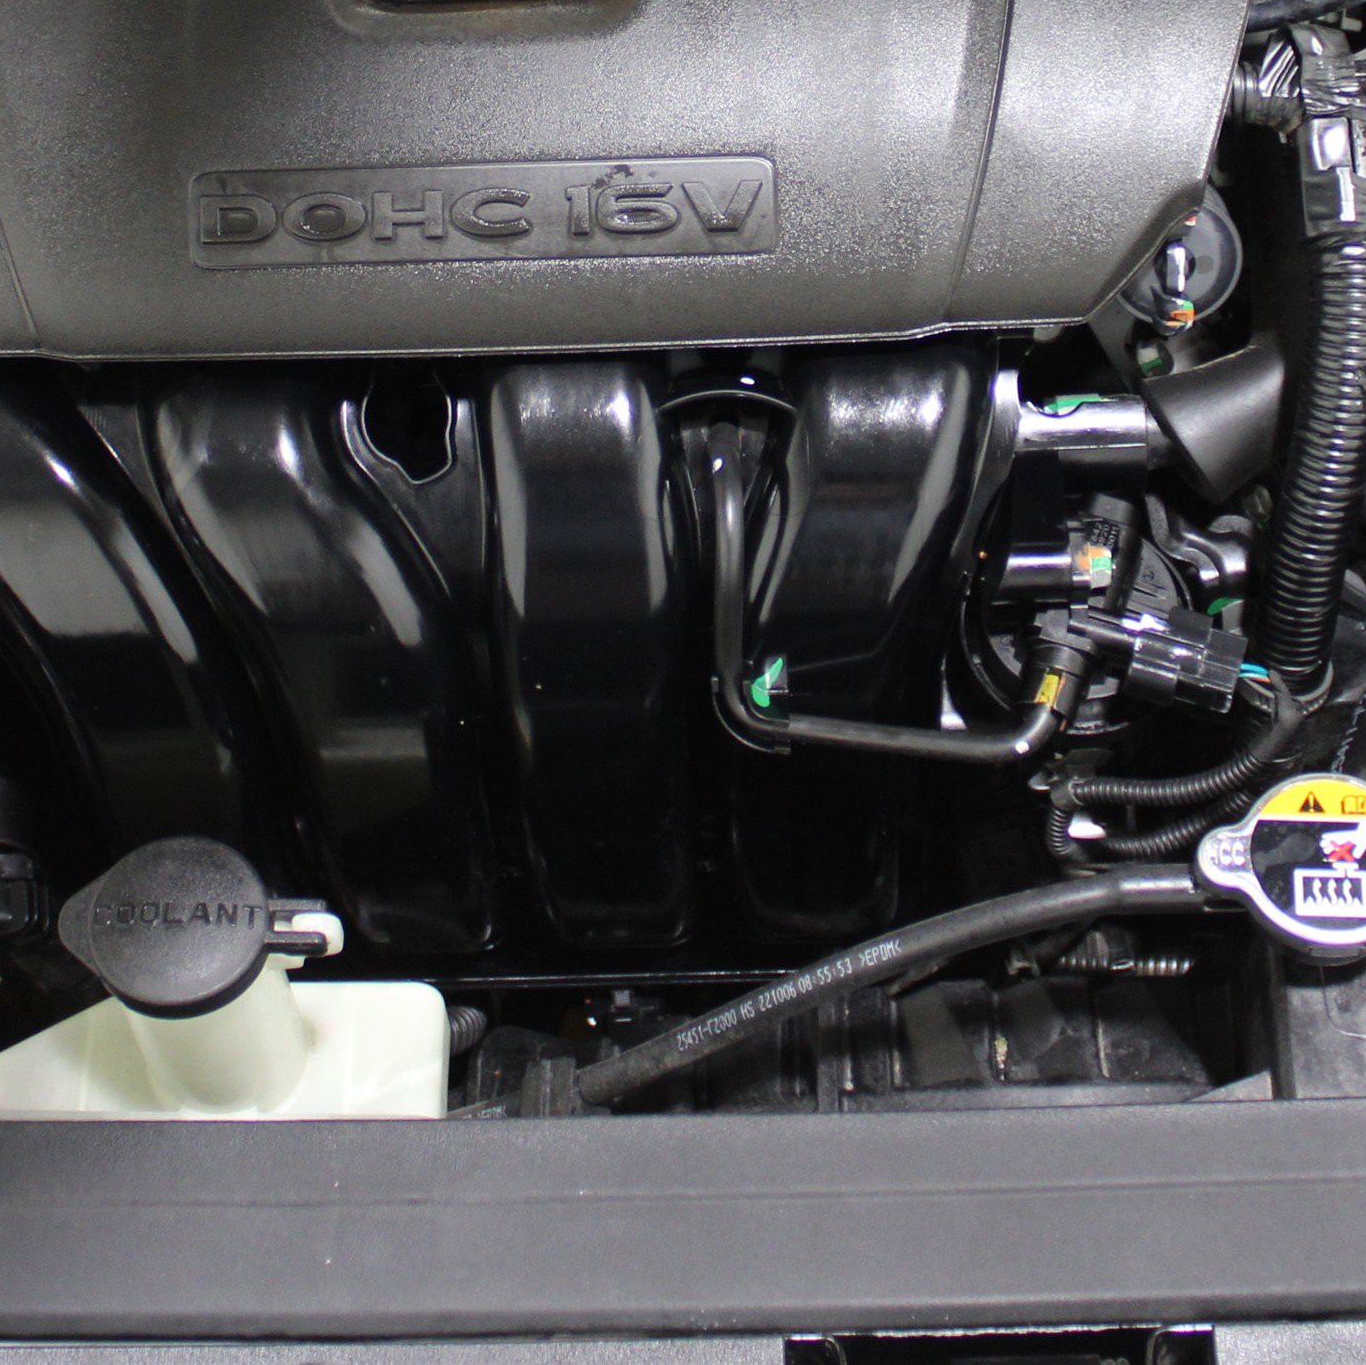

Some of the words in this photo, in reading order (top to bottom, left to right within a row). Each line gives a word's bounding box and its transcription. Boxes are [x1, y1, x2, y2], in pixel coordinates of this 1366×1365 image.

[199, 187, 531, 246] DOHC
[565, 179, 763, 236] 16V
[93, 902, 263, 930] COOLANT
[740, 1001, 755, 1021] HS
[758, 981, 797, 1012] 221006
[797, 957, 853, 994] 08:55:53
[858, 939, 903, 967] >EPDM<
